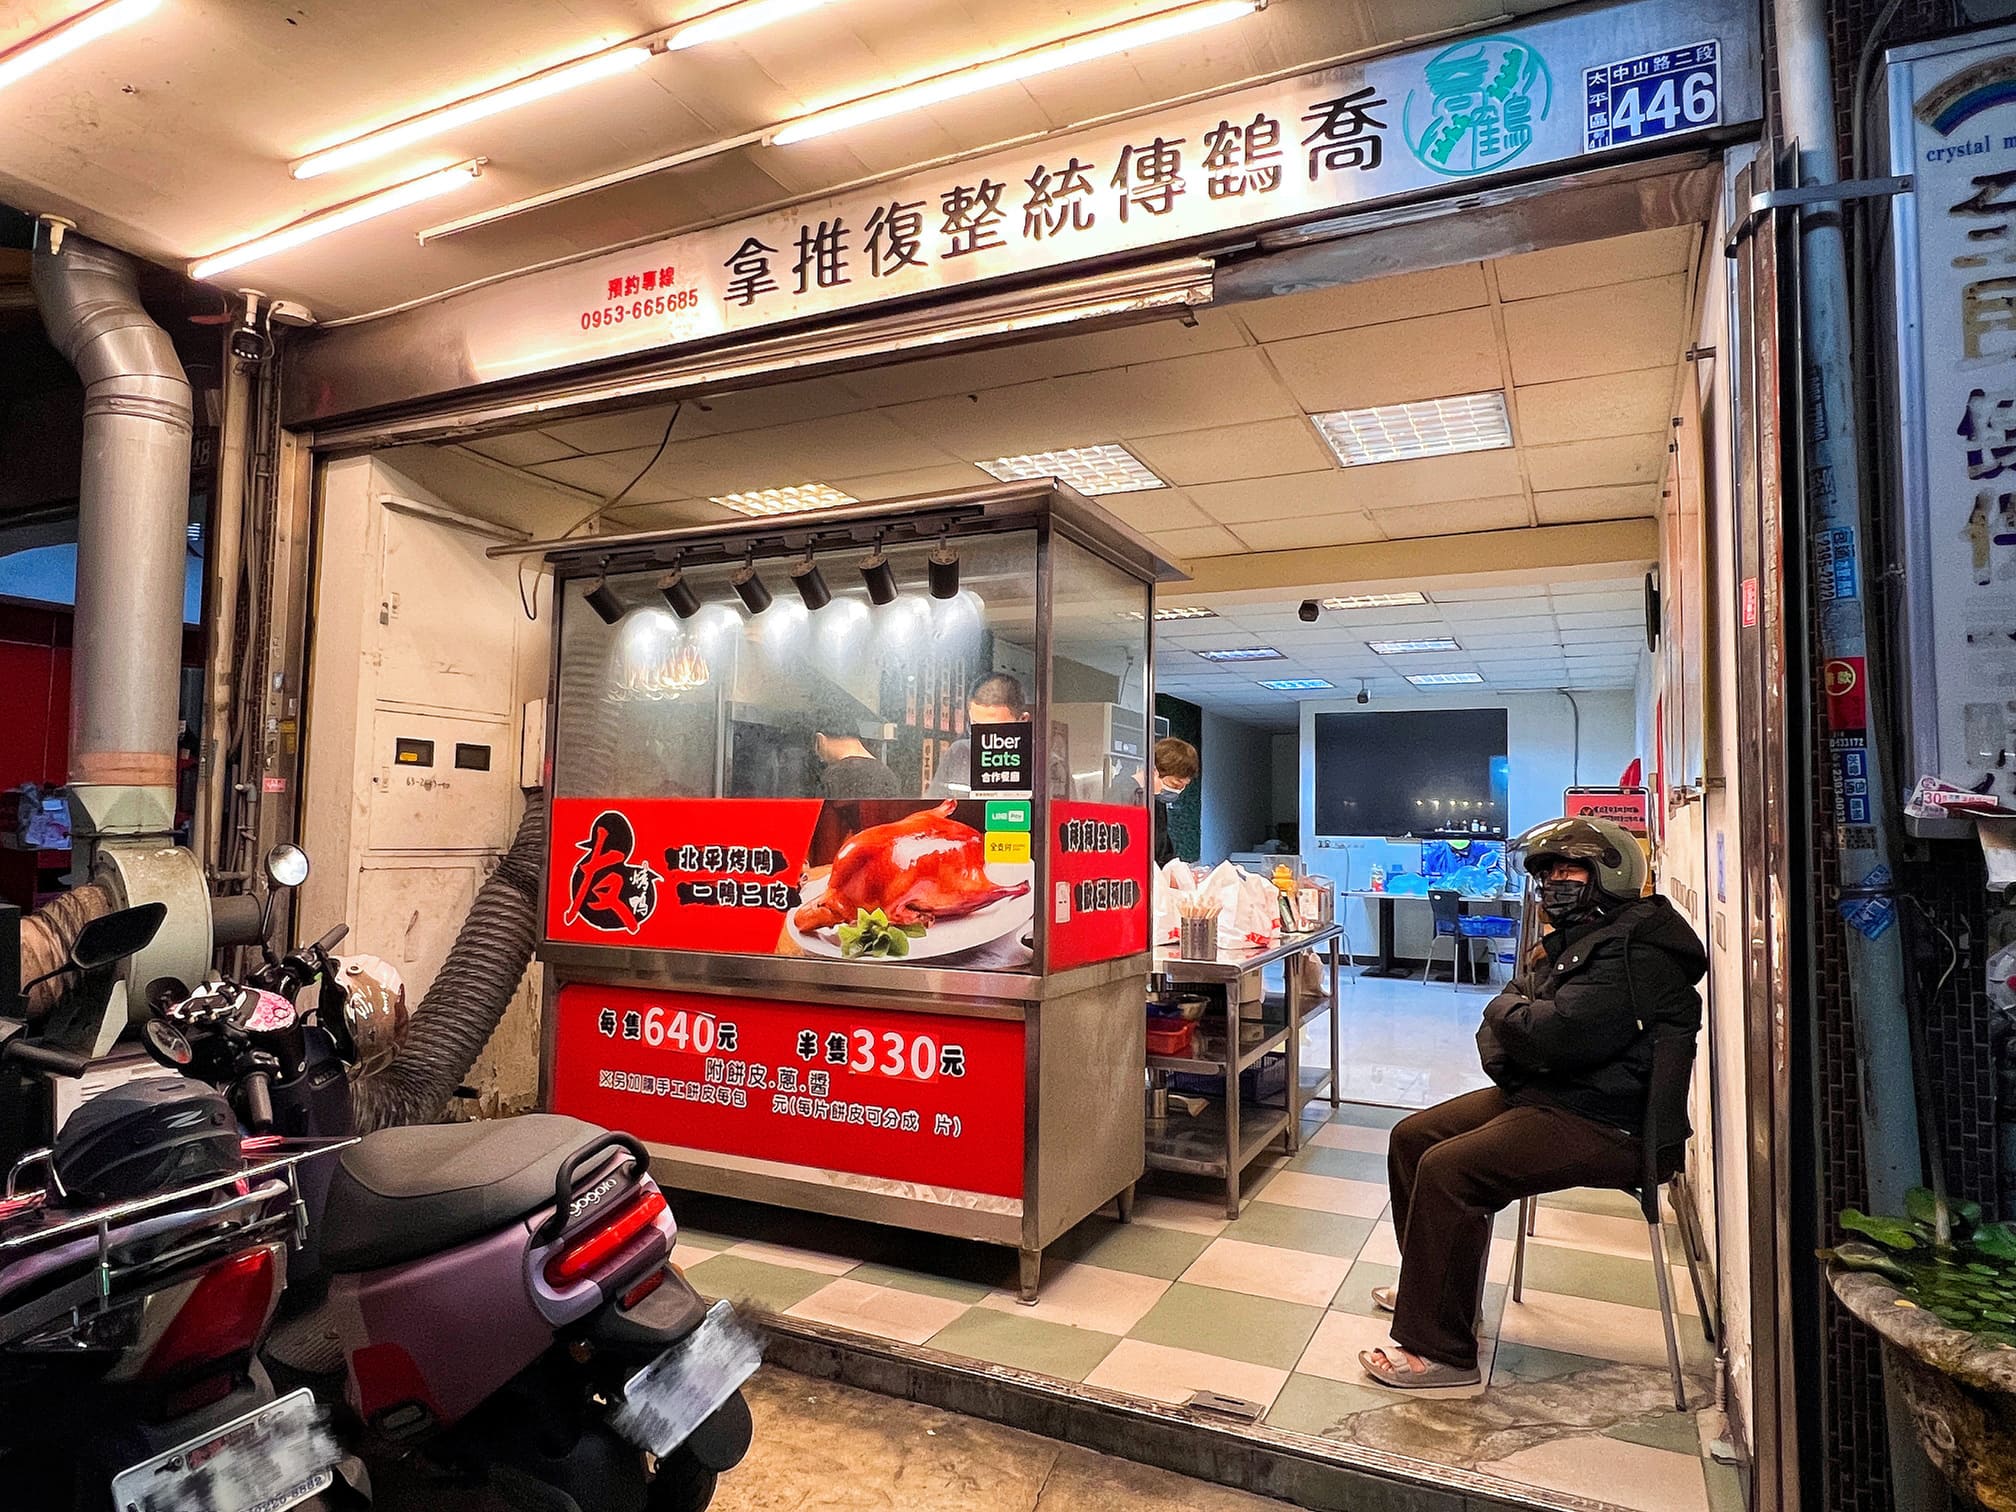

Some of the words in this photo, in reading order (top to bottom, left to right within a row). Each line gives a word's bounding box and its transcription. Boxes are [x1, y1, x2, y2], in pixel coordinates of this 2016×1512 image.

[1613, 45, 1714, 81] 中山路二段
[1588, 72, 1608, 129] 太平區
[1612, 72, 1716, 137] 446
[1926, 134, 1990, 164] crystal
[608, 266, 675, 300] 預約專線
[581, 288, 698, 330] 0953-665685
[981, 734, 1021, 749] Uber
[981, 751, 1021, 767] Eats
[678, 845, 773, 874] 北平烤鴨
[693, 878, 789, 909] 一鴨二吃
